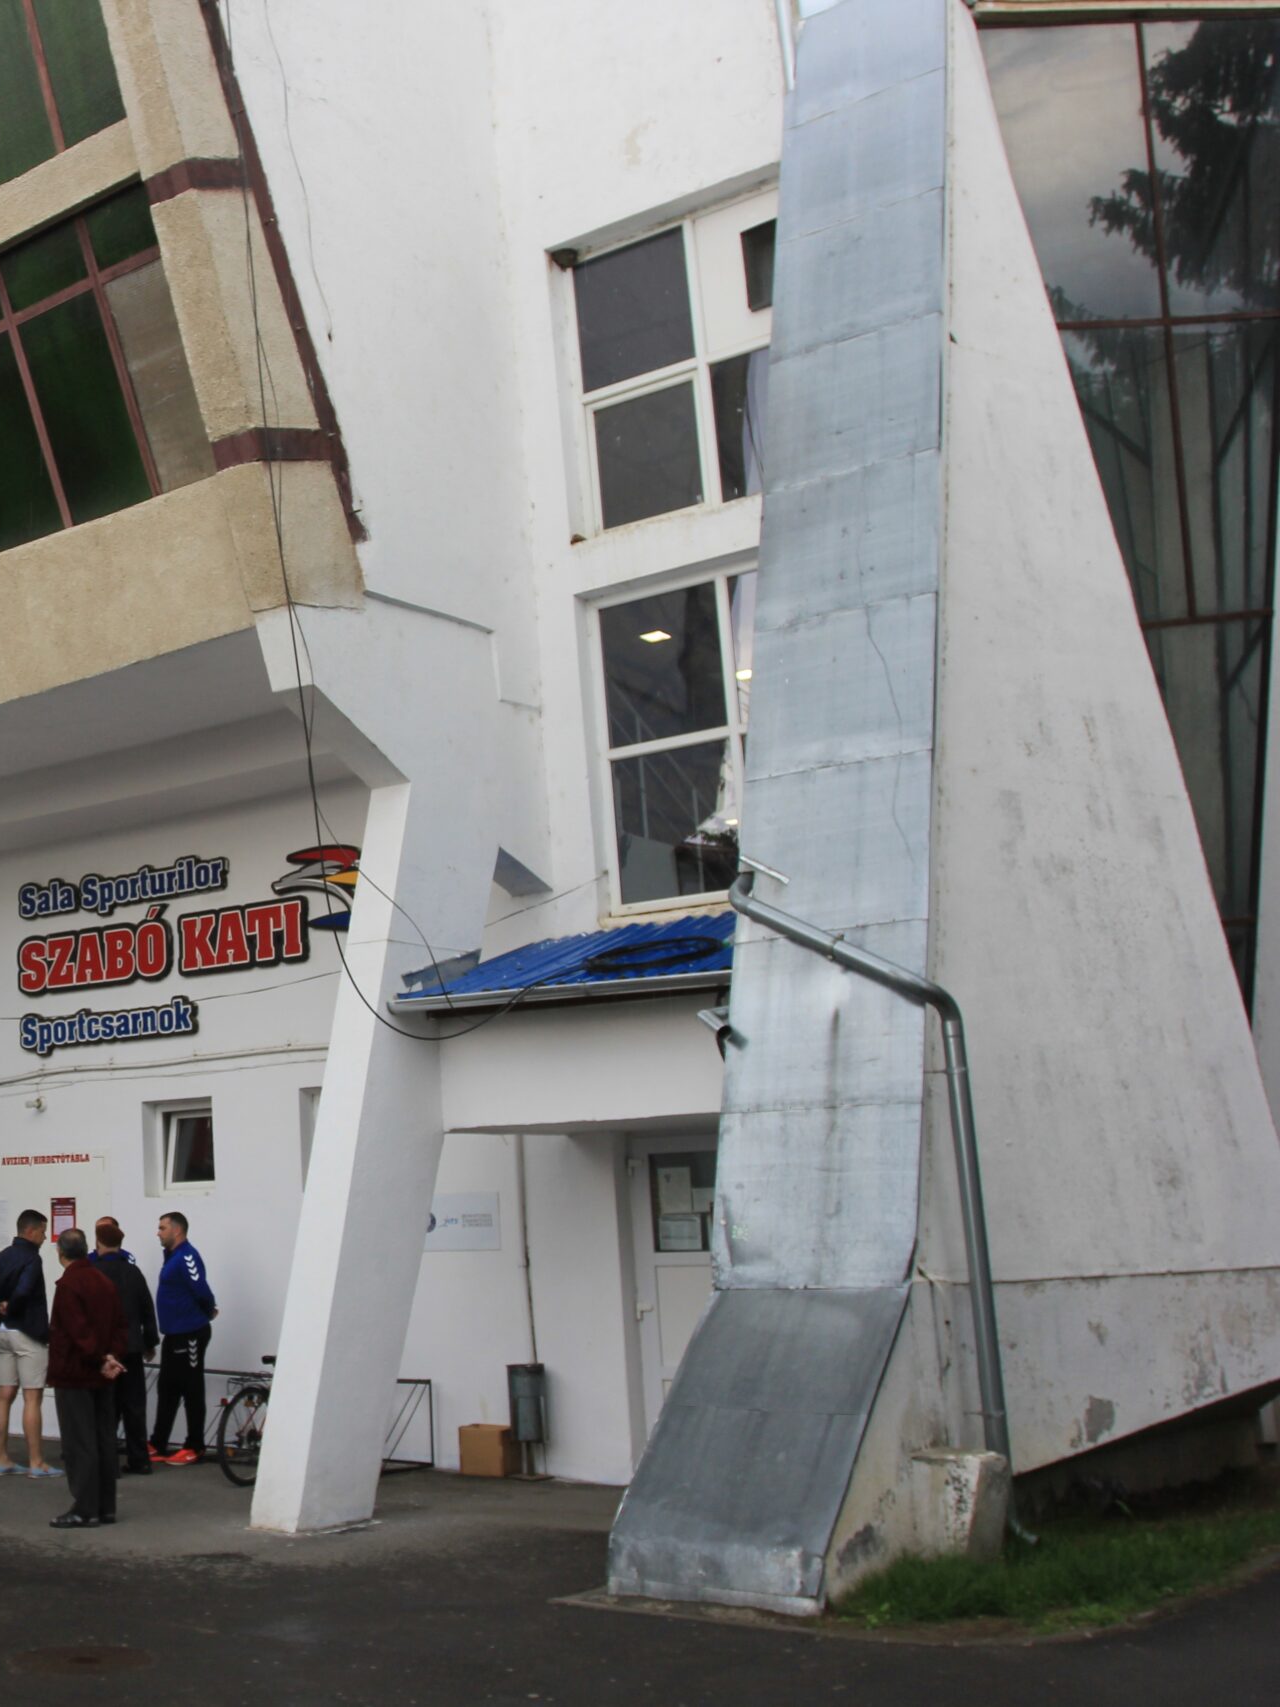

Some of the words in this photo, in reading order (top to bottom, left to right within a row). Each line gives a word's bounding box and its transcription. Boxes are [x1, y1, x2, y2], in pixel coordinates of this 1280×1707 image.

[21, 880, 75, 916] Sala
[81, 858, 224, 914] Sporturilor
[20, 905, 168, 993] SZABÓ
[180, 900, 305, 971] KATI
[21, 999, 193, 1054] Sportcsarnok
